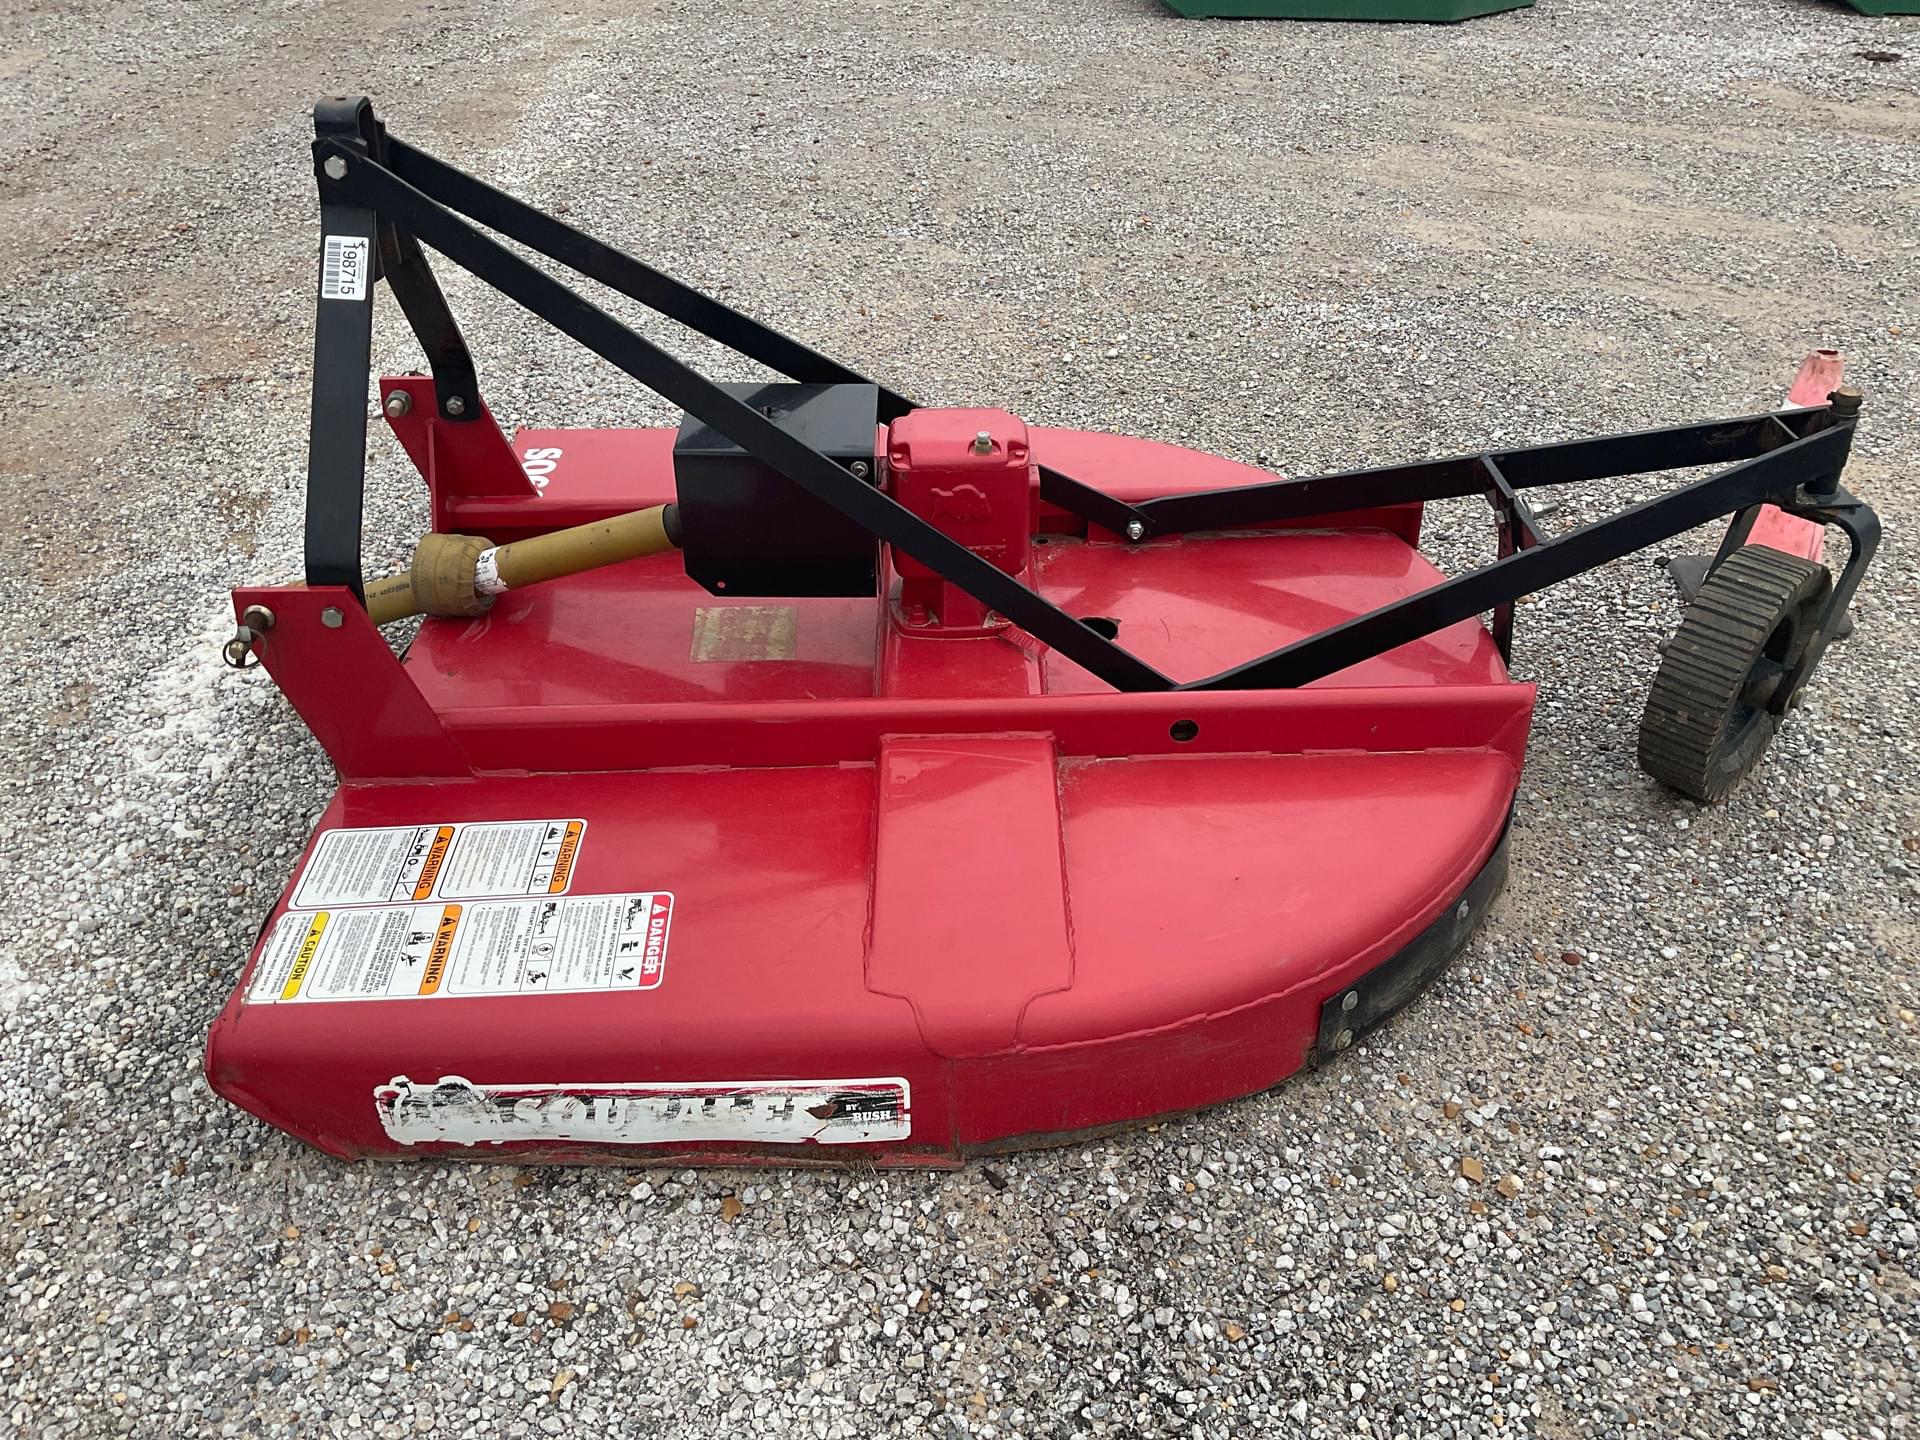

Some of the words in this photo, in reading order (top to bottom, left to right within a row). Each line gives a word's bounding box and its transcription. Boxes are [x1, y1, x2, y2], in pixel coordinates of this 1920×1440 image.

[340, 243, 357, 295] 198715
[418, 846, 444, 888] WARNING
[553, 840, 575, 882] WARNING
[291, 940, 316, 979] CAUTION
[425, 930, 451, 983] WARNING
[643, 918, 664, 974] DANGER
[845, 1103, 858, 1112] BY
[852, 1110, 891, 1122] BUSH
